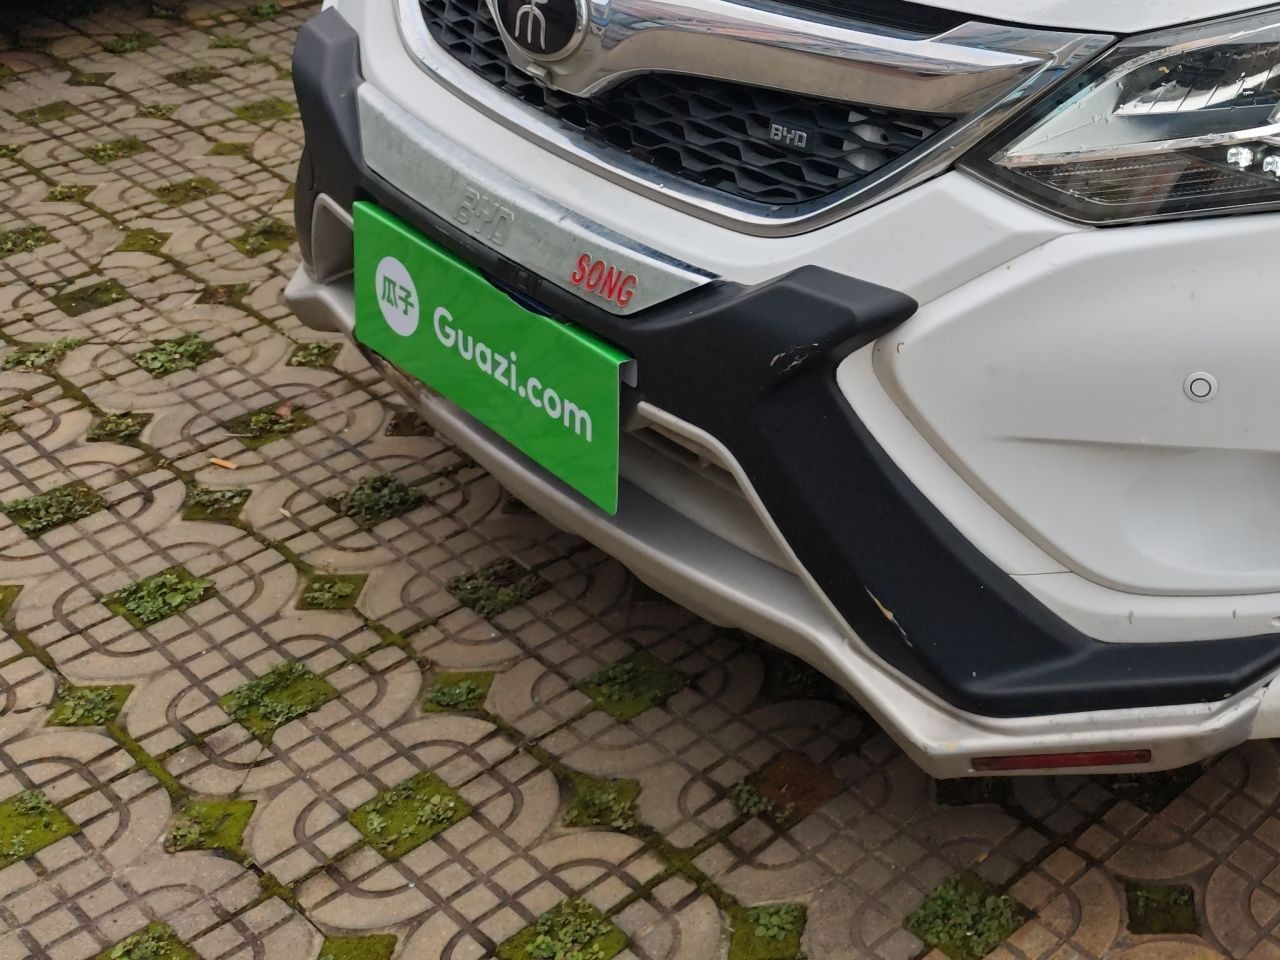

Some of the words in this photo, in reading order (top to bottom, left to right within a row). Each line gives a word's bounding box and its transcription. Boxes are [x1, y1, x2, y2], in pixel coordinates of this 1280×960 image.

[770, 123, 807, 148] BYD
[454, 187, 515, 246] BYD
[381, 275, 415, 316] 瓜子
[570, 252, 638, 308] SONG
[433, 306, 592, 442] Guazi.com
